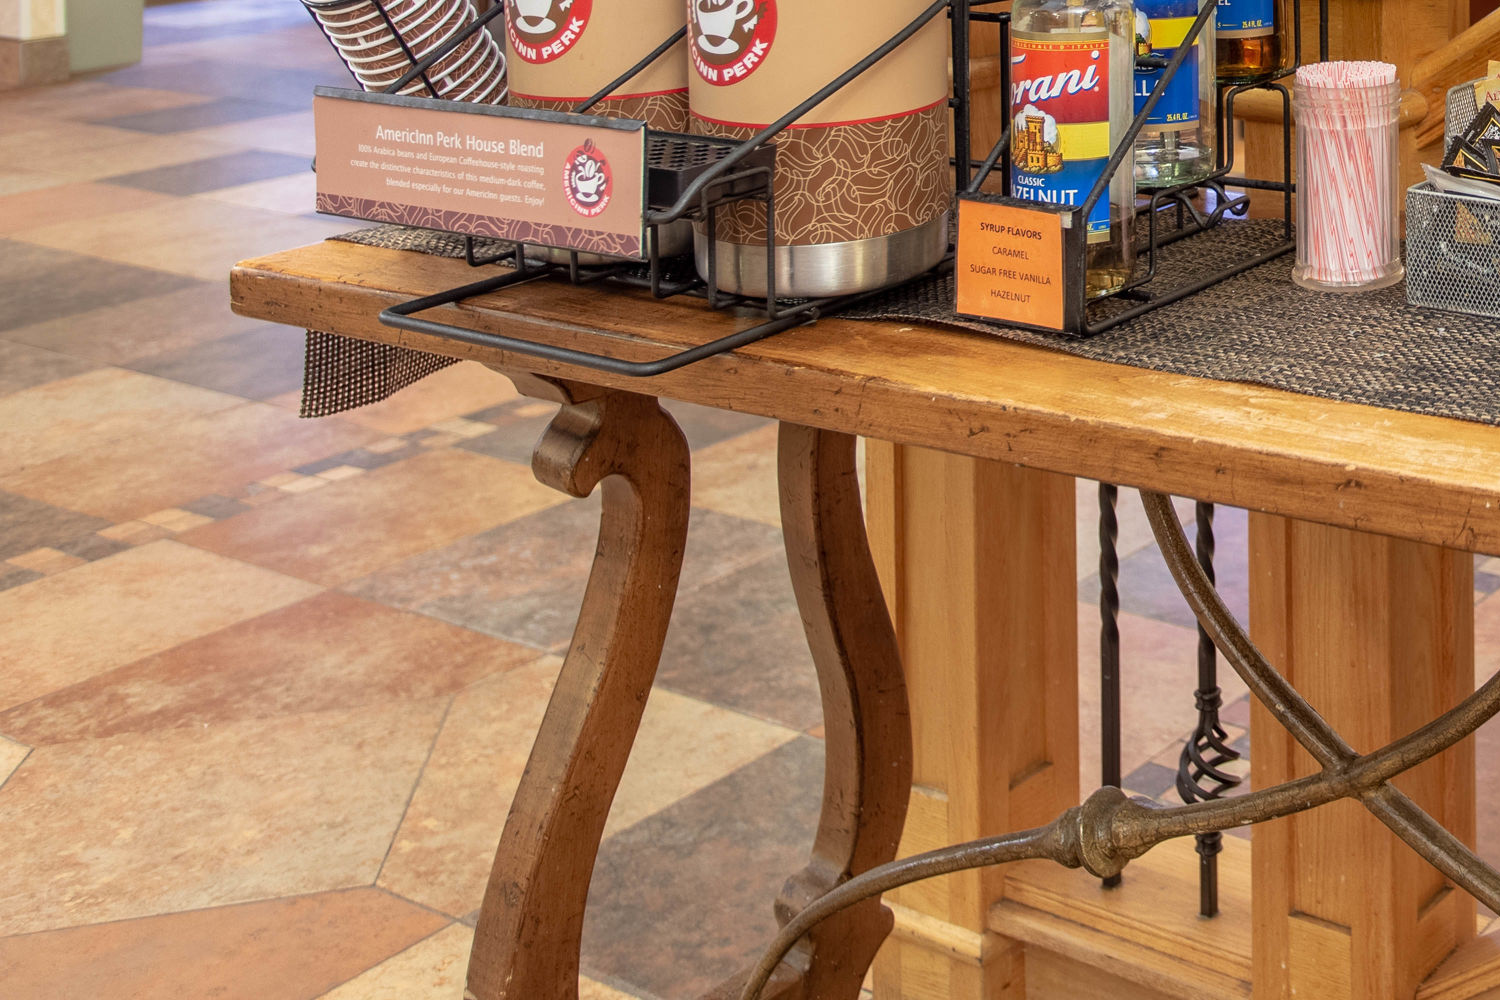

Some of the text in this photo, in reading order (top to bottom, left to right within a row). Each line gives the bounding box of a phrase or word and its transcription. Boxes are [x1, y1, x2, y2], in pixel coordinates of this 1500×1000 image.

[541, 16, 585, 60] PERK
[723, 38, 769, 83] PERK
[375, 124, 544, 158] AmericInn Perk House Blend
[358, 143, 373, 153] 100%
[373, 146, 396, 156] Arabica
[396, 149, 415, 159] beans
[415, 152, 428, 161] and
[429, 153, 458, 164] European
[517, 163, 545, 176] roasting
[350, 159, 547, 192] create the distinctive characteristics of this medium-dark coffee,
[563, 162, 610, 216] AMERICINN PERK
[1017, 175, 1046, 187] CLASSIC
[386, 177, 411, 188] blended
[411, 181, 441, 193] especially
[442, 184, 452, 193] for
[453, 187, 464, 195] our
[524, 194, 545, 207] Enjoy!
[980, 222, 1042, 241] SYRUP FLAVORS
[991, 245, 1030, 261] CARAMEL
[969, 264, 1052, 286] SUGAR FREE VANILLA
[990, 288, 1031, 303] HAZELNUT
